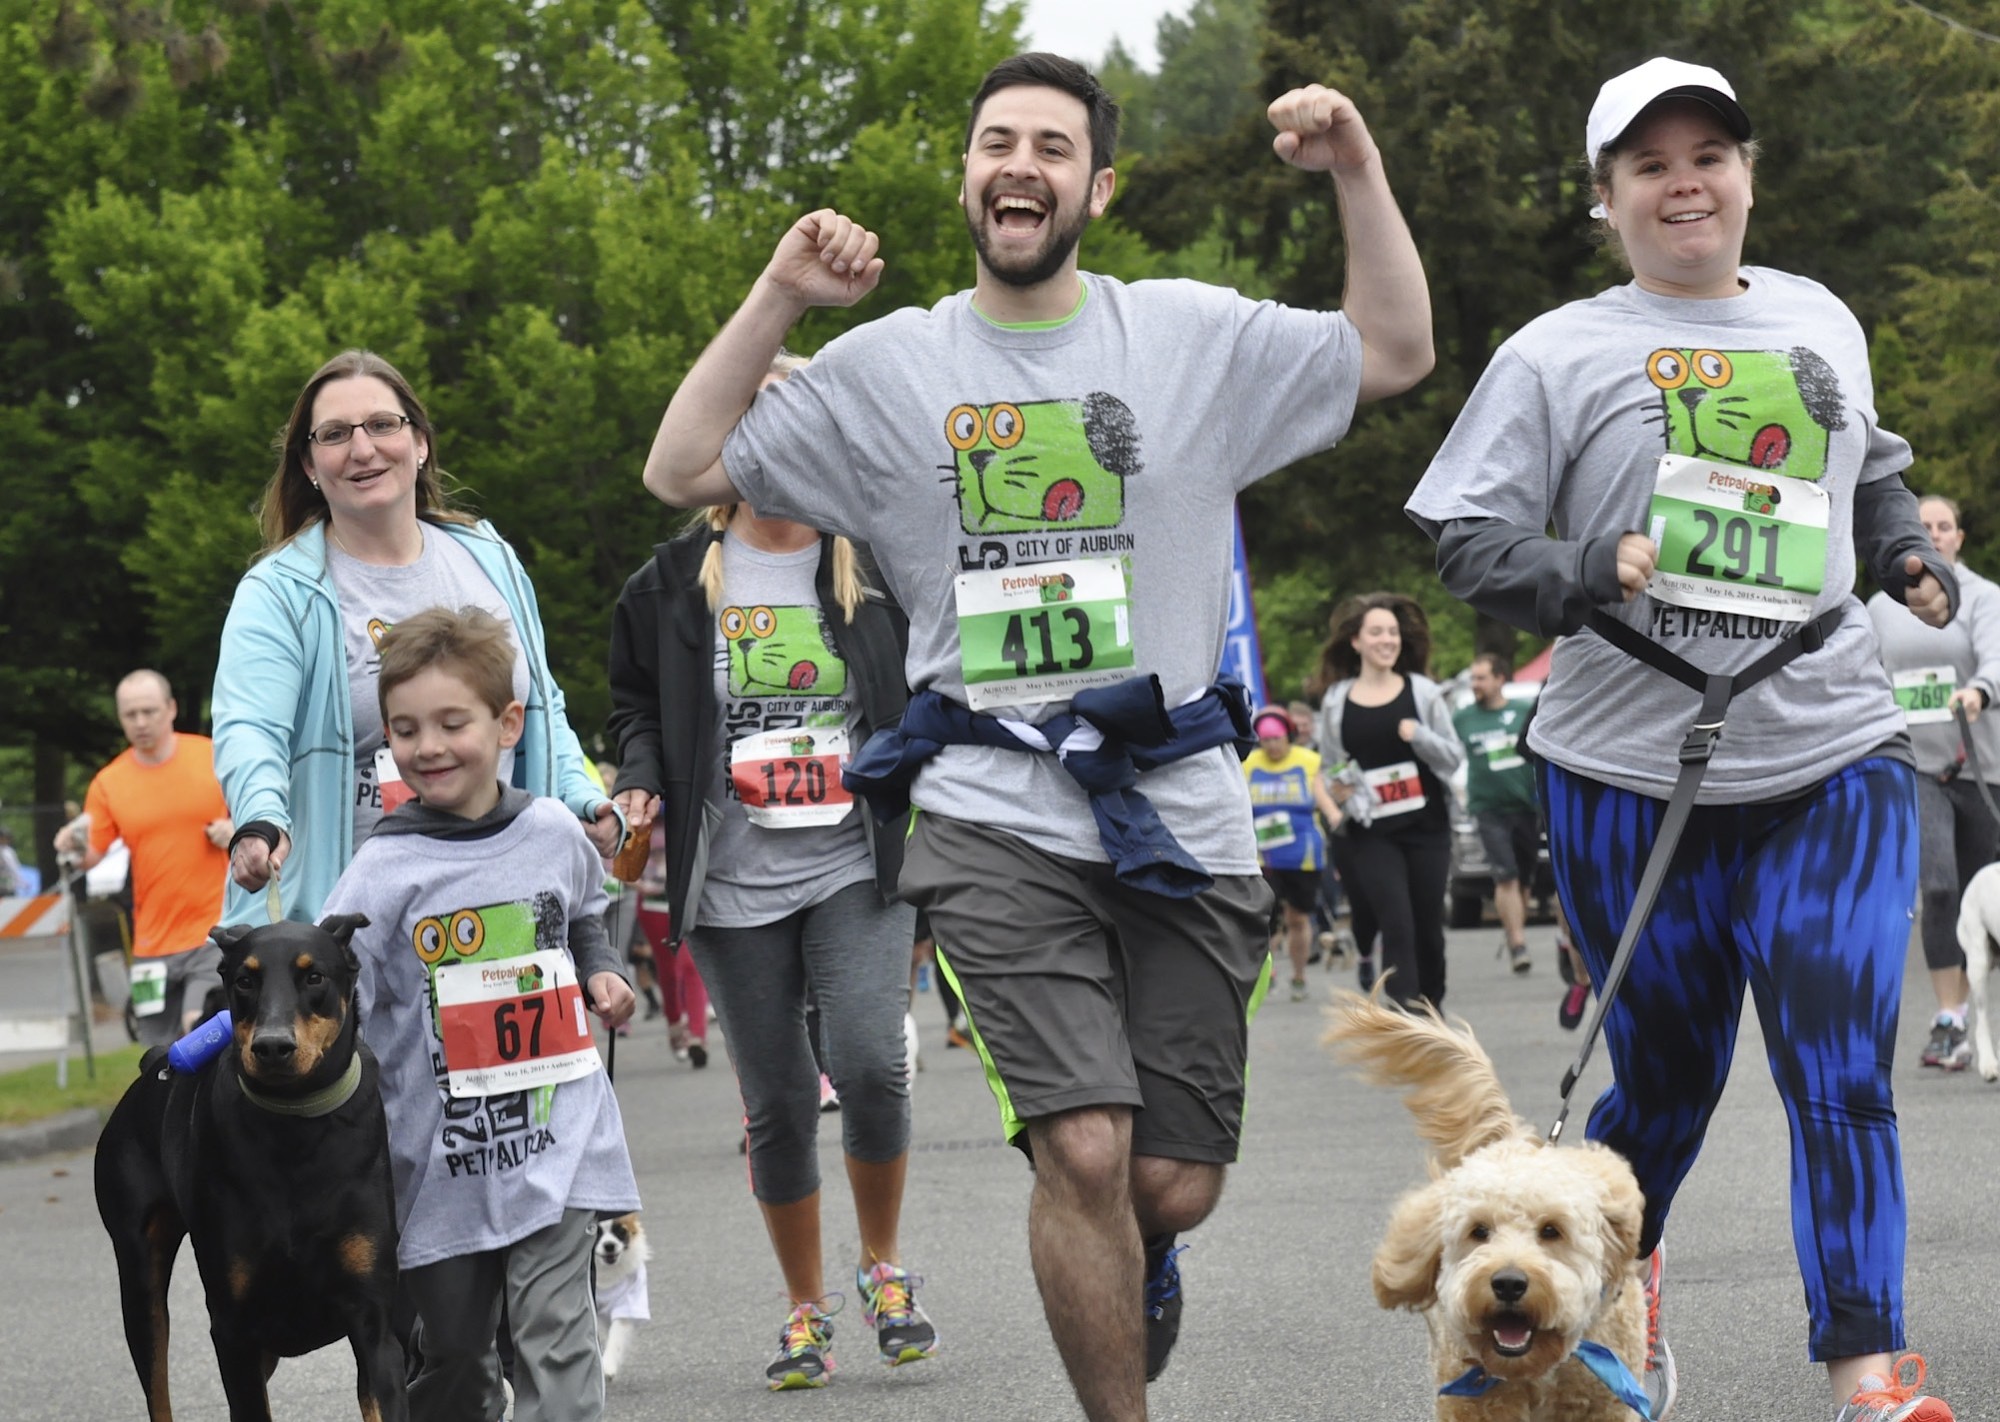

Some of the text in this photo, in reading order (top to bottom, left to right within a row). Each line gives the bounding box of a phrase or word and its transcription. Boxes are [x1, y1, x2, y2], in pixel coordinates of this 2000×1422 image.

[1016, 534, 1135, 557] CITY OF AUBURN
[1686, 509, 1783, 586] 291
[1659, 577, 1695, 592] AUBURN
[1704, 586, 1721, 597] May
[1737, 589, 1755, 600] 2015
[1001, 607, 1094, 677] 413
[767, 700, 851, 713] CITY OF AUBURN
[1909, 684, 1944, 711] 269
[760, 758, 826, 808] 120
[494, 997, 546, 1062] 67
